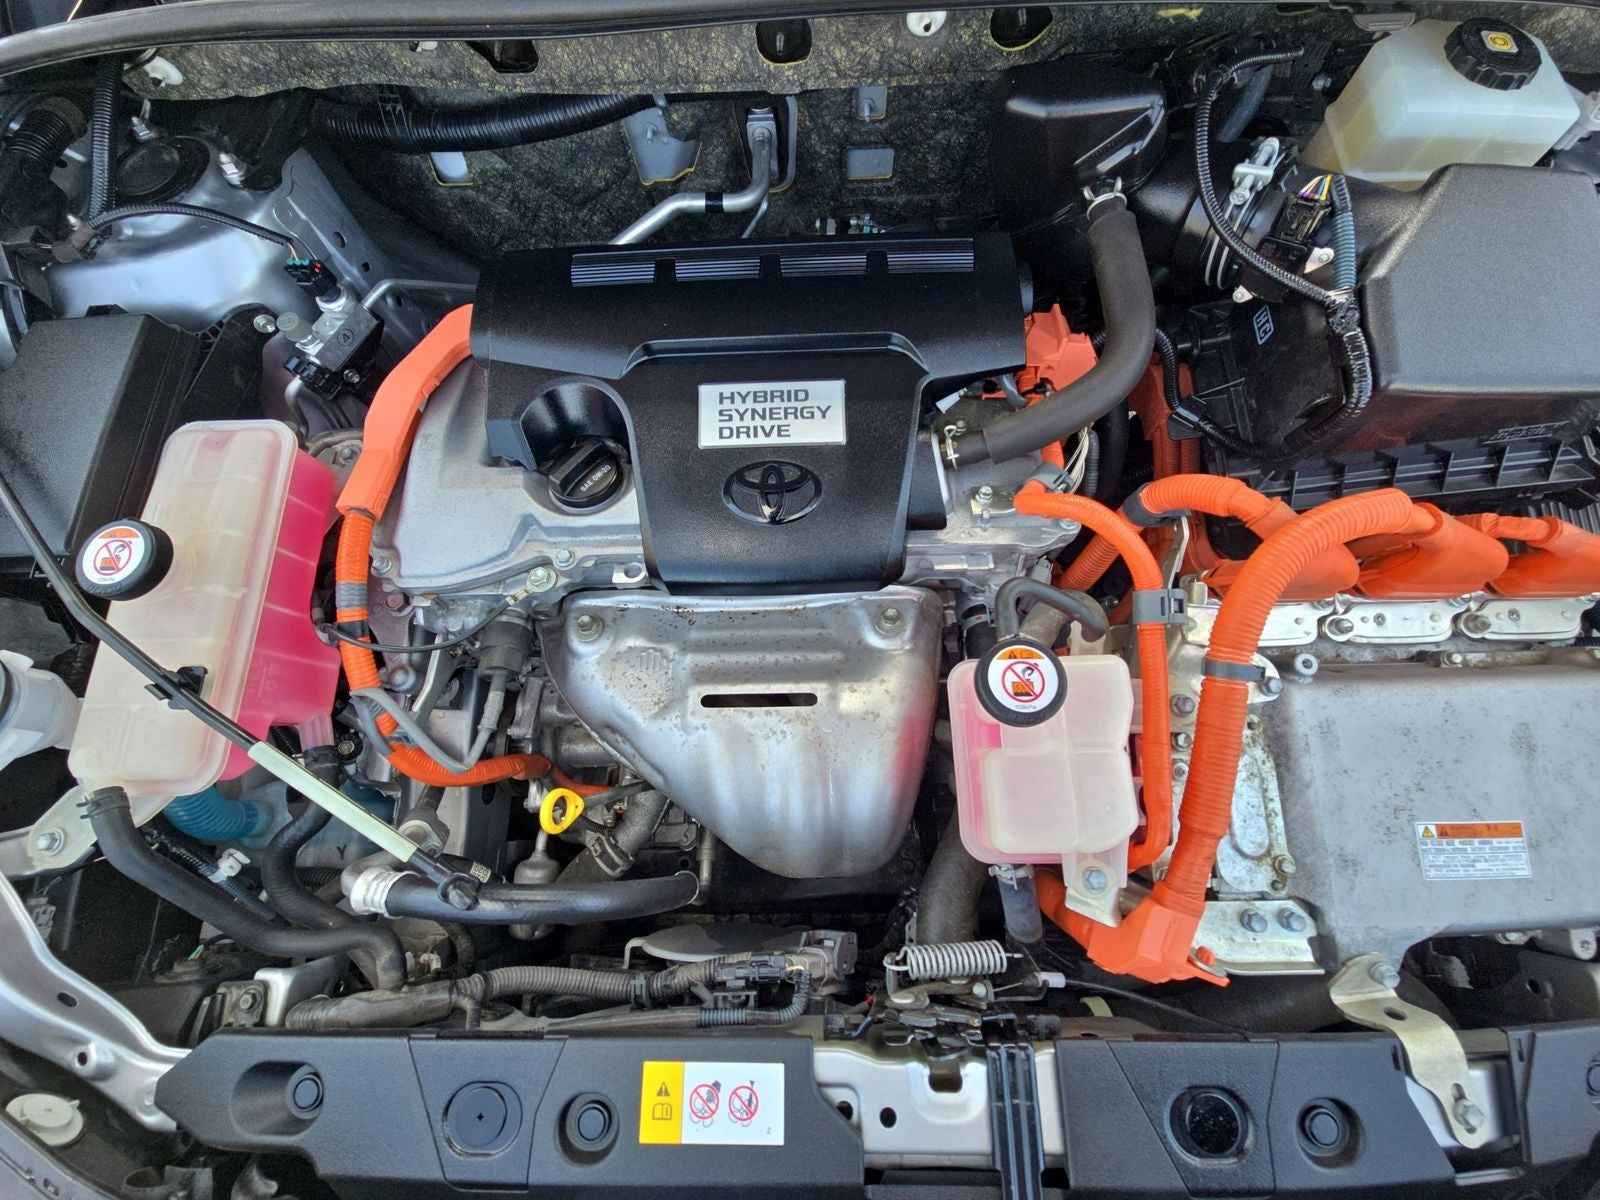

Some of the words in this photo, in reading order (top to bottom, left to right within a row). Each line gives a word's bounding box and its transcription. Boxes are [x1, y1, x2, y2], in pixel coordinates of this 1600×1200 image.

[718, 389, 809, 405] HYBRID
[718, 405, 832, 422] SYNERGY
[718, 424, 791, 440] DRIVE
[580, 479, 594, 492] SAE
